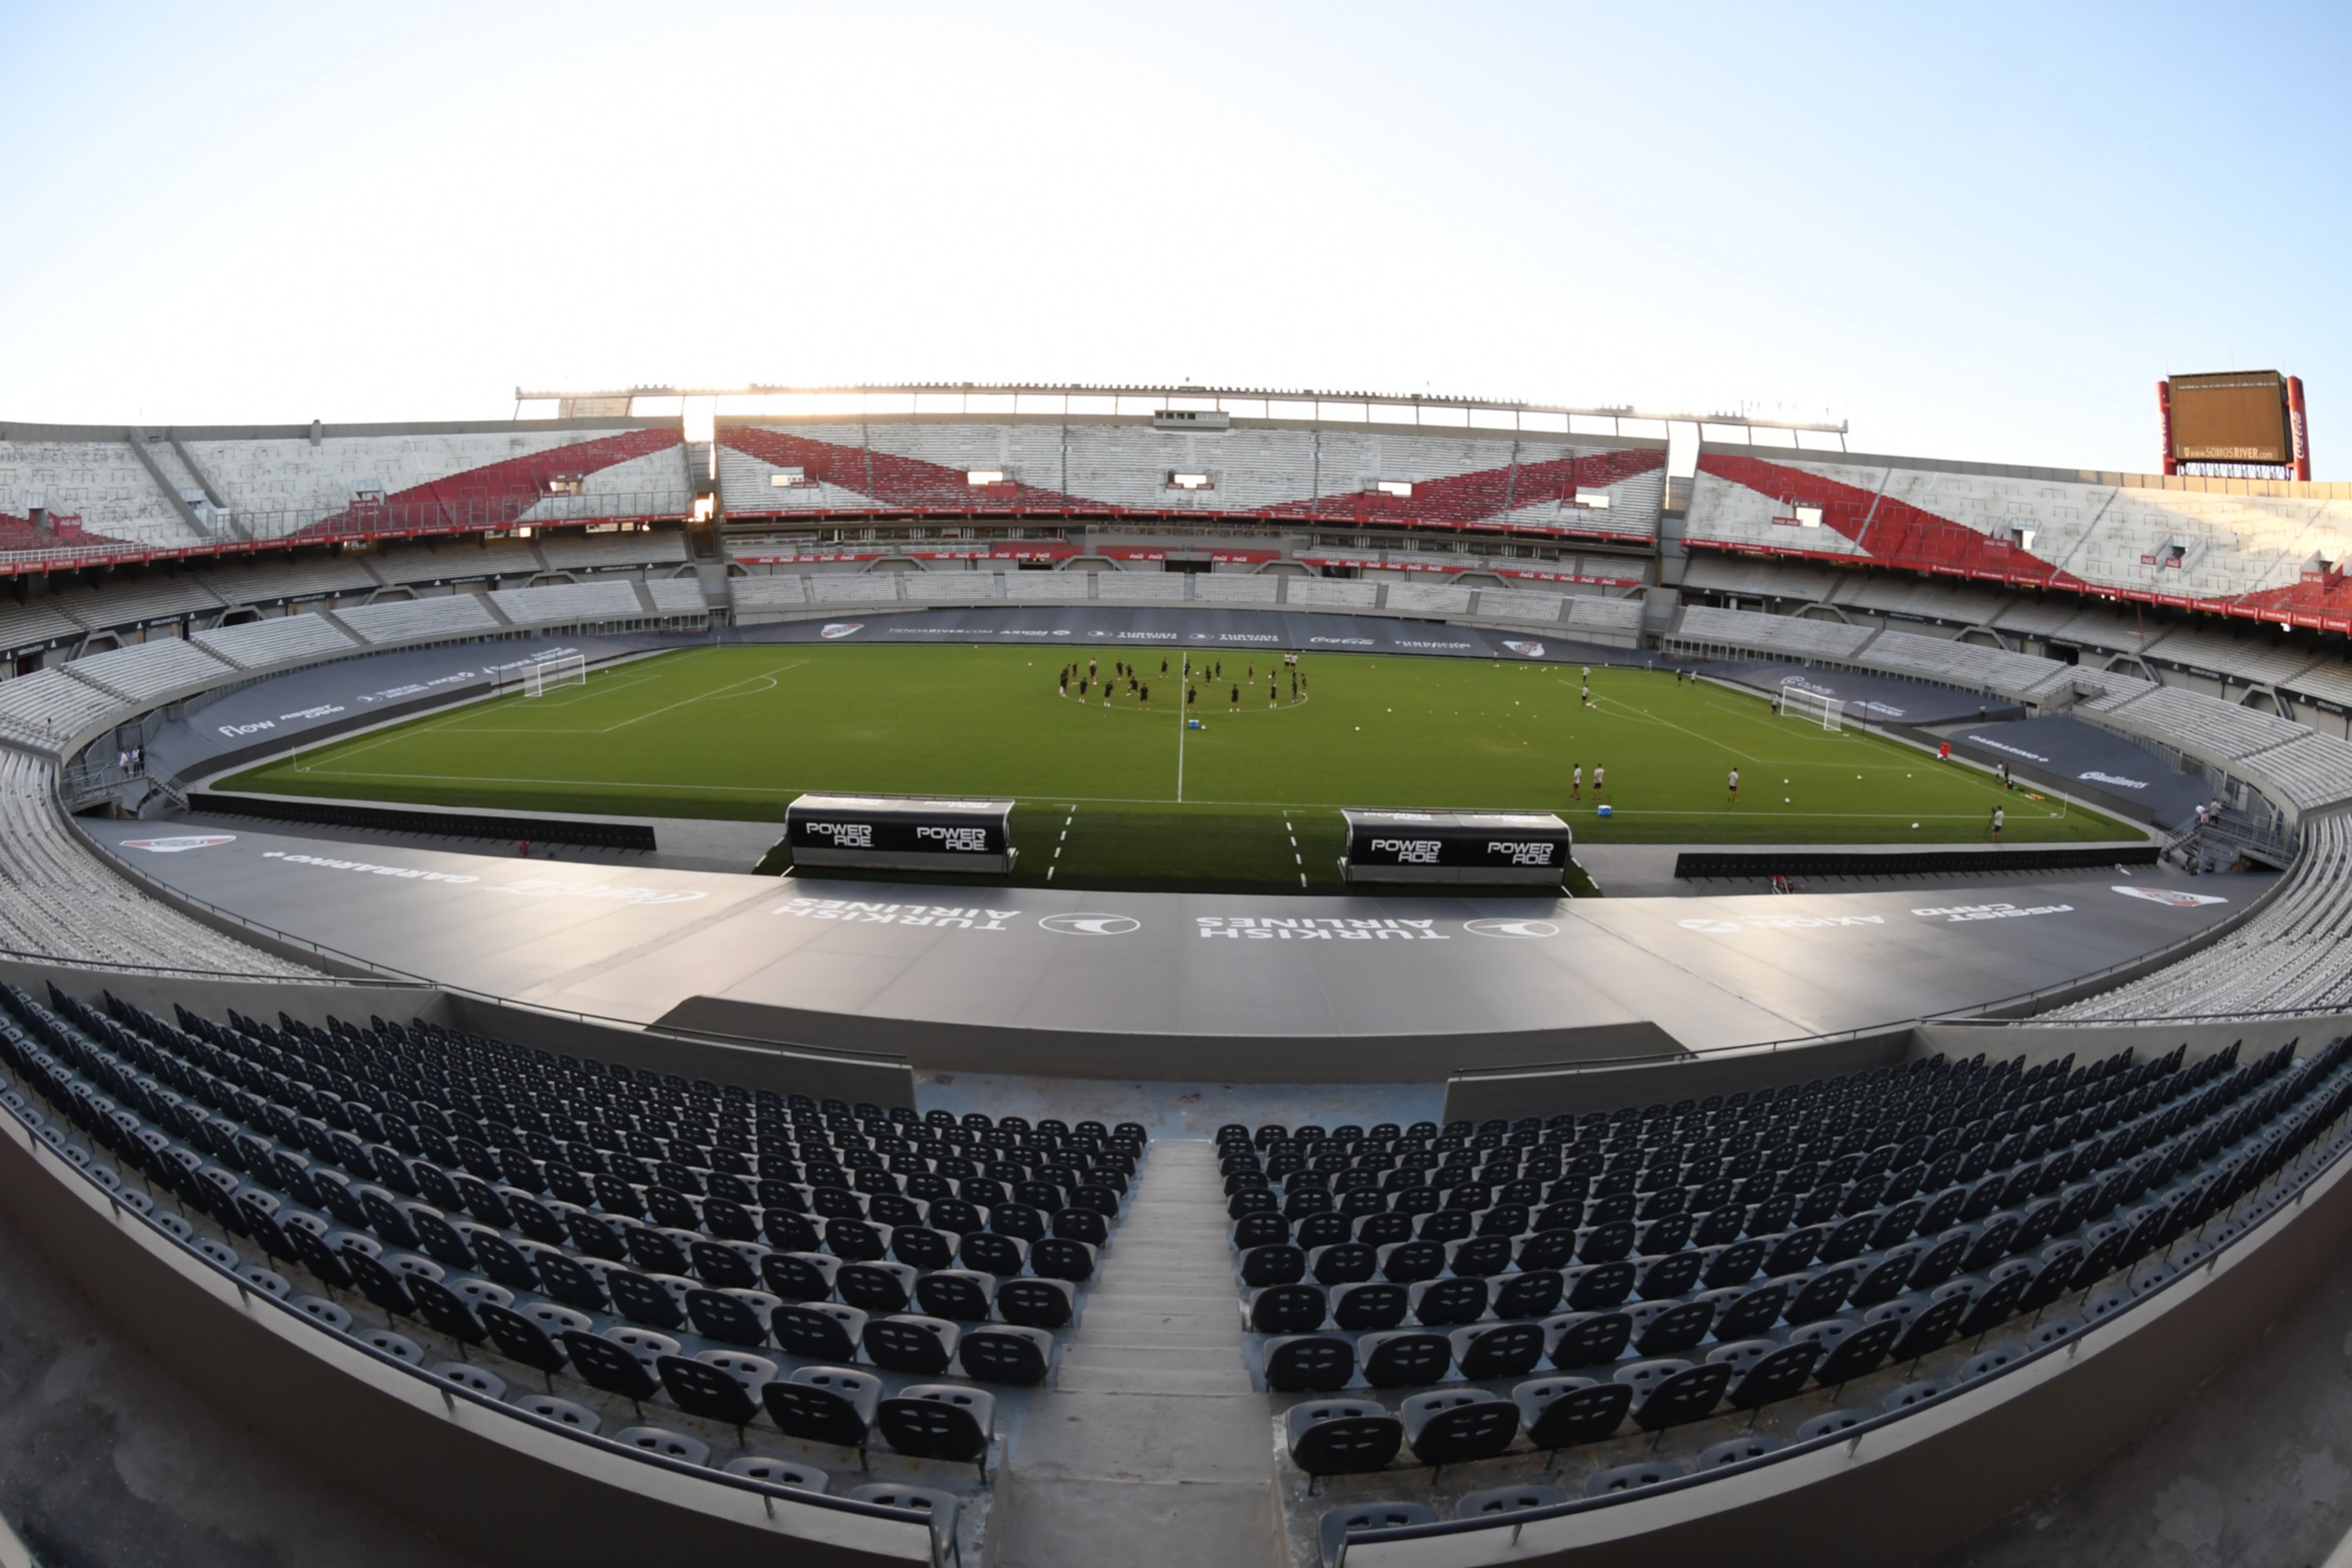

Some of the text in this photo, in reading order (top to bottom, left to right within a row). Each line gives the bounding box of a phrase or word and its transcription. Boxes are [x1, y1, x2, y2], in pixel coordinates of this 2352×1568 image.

[219, 720, 276, 738] flow
[805, 822, 873, 837] POWER
[916, 827, 986, 840] POWER
[834, 835, 873, 848] ADE
[946, 839, 985, 851] ADE
[1371, 840, 1442, 852] POWER
[1487, 842, 1554, 855] POWER
[1398, 851, 1438, 863] ADE
[1512, 854, 1551, 865] ADE
[283, 855, 479, 884] GARBARINO
[786, 897, 1023, 920] AIRLINES
[771, 906, 1007, 931] TURKISH
[1196, 917, 1434, 928] AIRLINES
[1200, 927, 1451, 939] TURKISH
